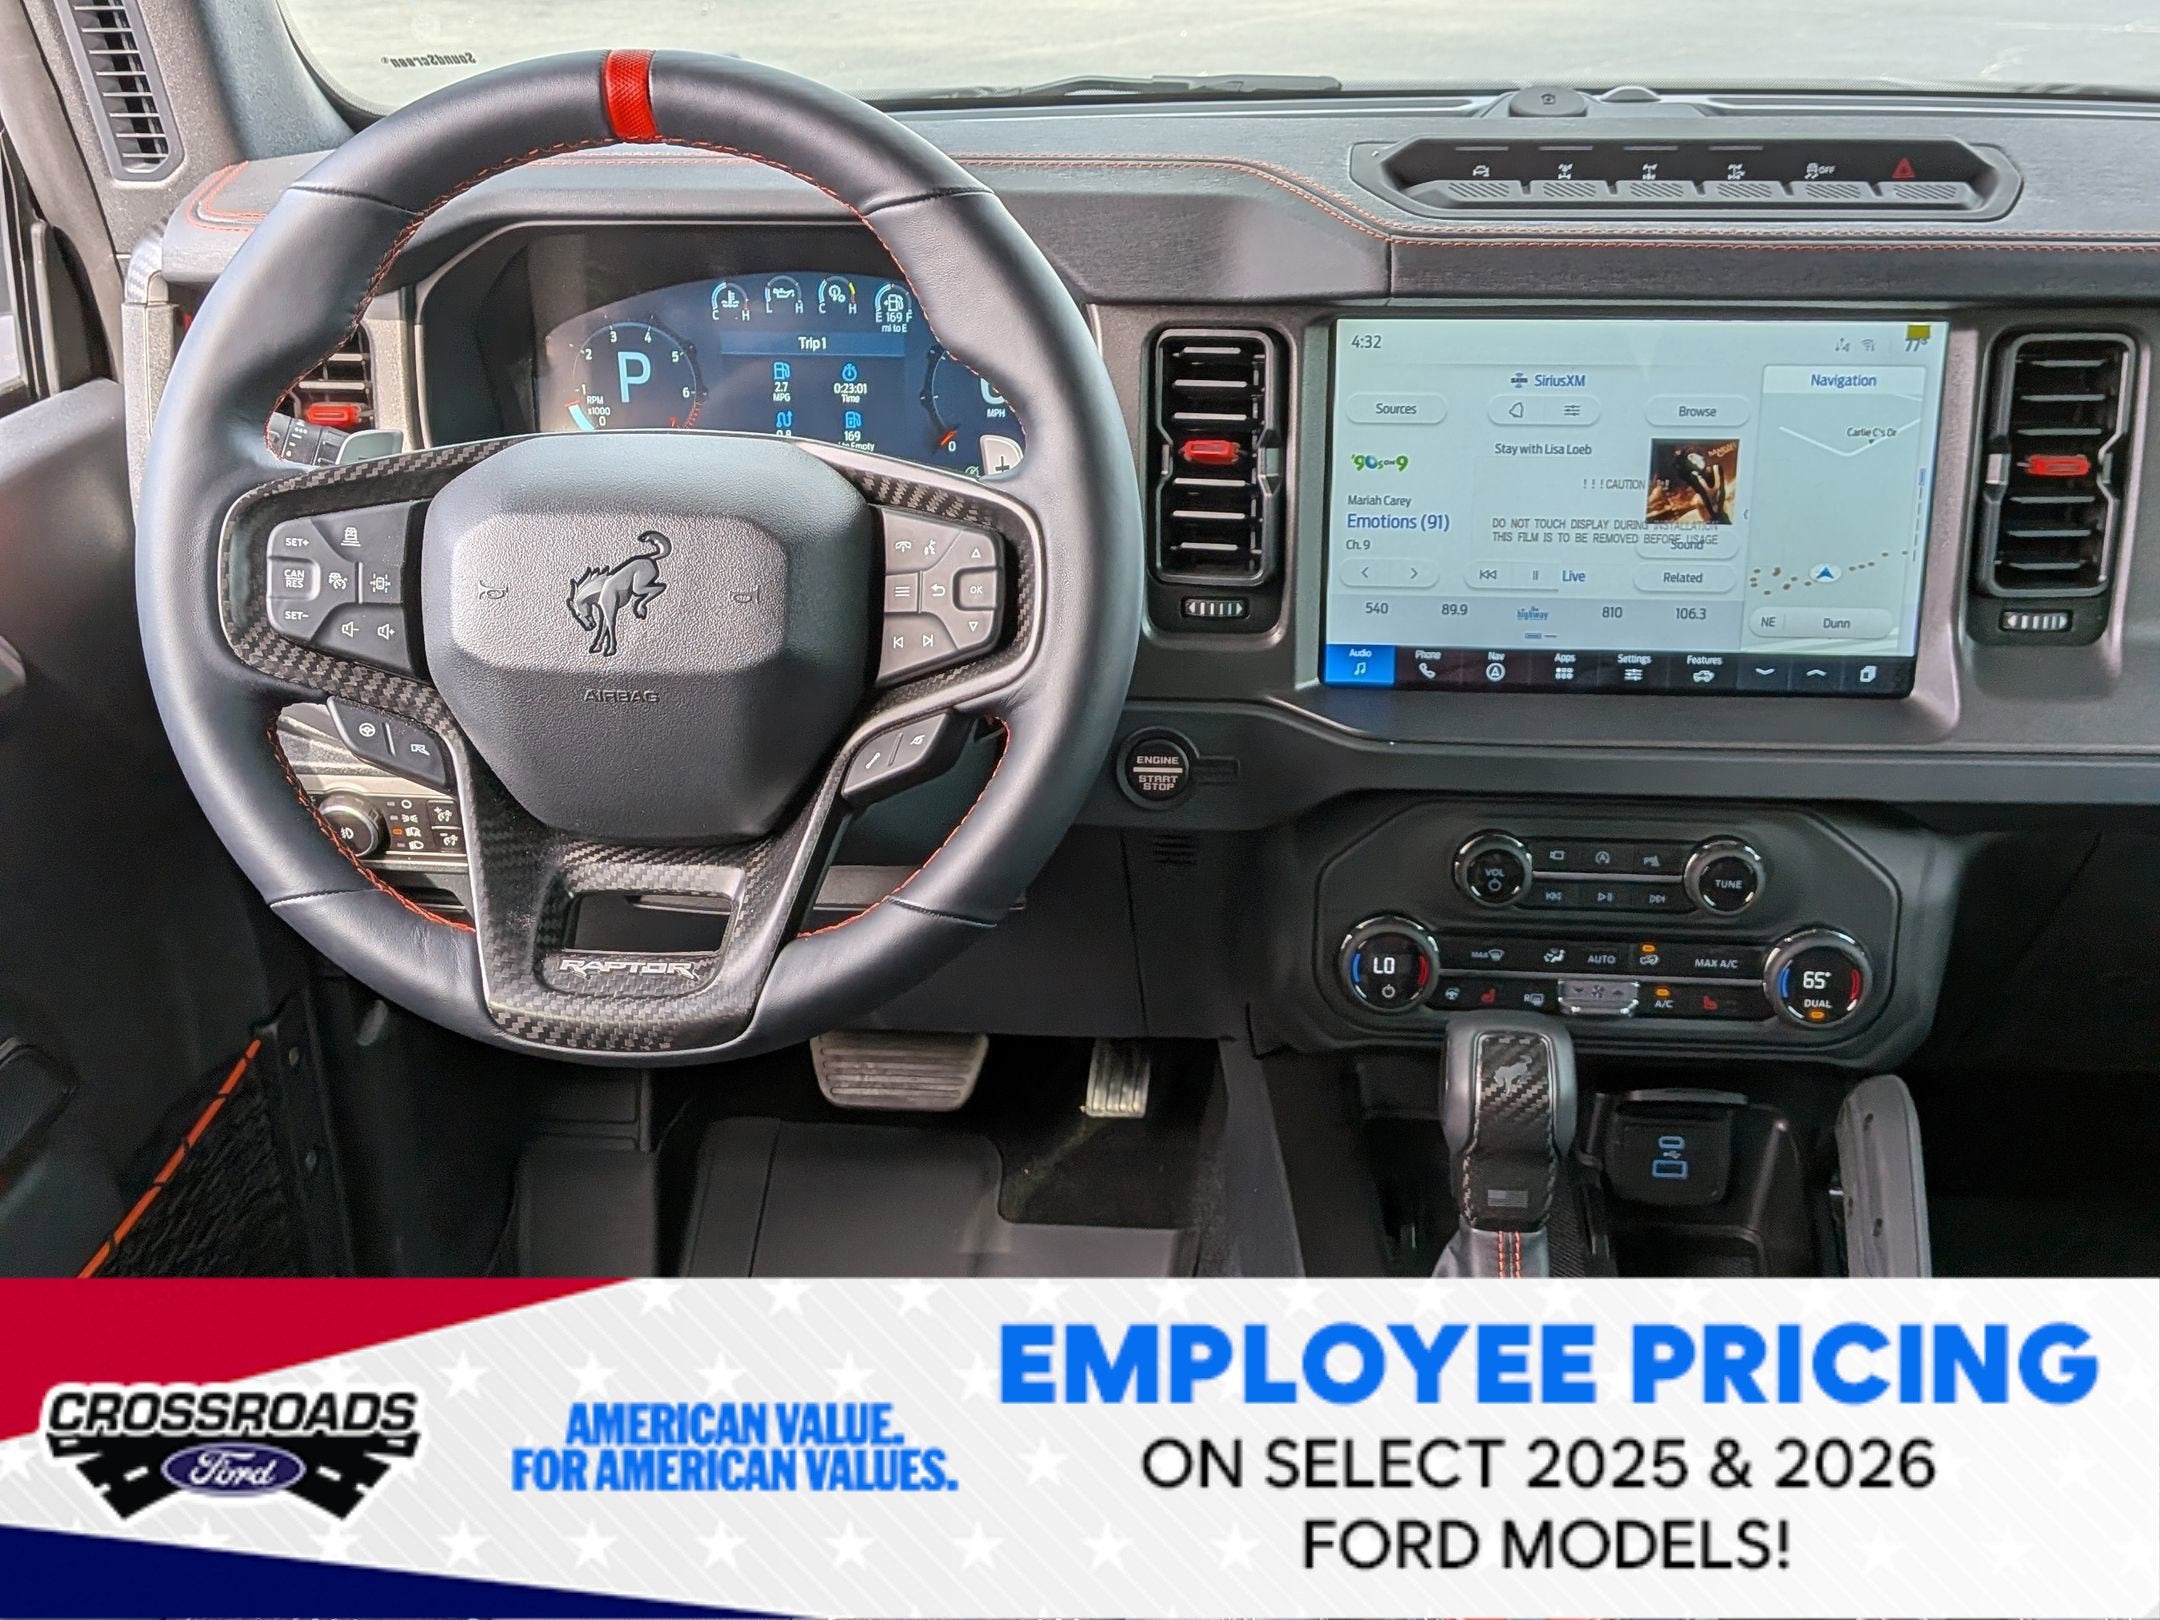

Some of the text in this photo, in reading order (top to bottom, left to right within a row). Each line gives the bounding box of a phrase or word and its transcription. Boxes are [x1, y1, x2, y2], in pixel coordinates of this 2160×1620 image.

[610, 334, 618, 343] 3
[644, 334, 652, 344] 4
[798, 337, 819, 352] Trip
[1351, 334, 1382, 350] 4:32
[585, 349, 593, 361] 2
[671, 350, 680, 363] 5
[617, 351, 651, 403] P
[1534, 374, 1586, 388] SiriusXM
[1811, 373, 1877, 389] Navigation
[681, 386, 690, 399] 6
[774, 381, 789, 393] 2.7
[833, 382, 868, 395] 0:23:01
[586, 395, 604, 405] RPM
[772, 392, 791, 403] MPG
[841, 393, 861, 404] Time
[986, 408, 1006, 419] MPH
[1376, 402, 1417, 416] Sources
[1678, 405, 1717, 418] Browse
[598, 415, 607, 427] 0
[844, 430, 861, 442] 169
[948, 441, 957, 453] 0
[1495, 443, 1592, 456] Stay with Lisa Loeb
[1605, 479, 1646, 489] CAUTION
[1347, 495, 1412, 508] Mariah Carey
[1347, 513, 1450, 532] Emotions (91)
[1492, 518, 1506, 529] DO
[1511, 518, 1530, 529] NOT
[1535, 518, 1566, 530] TOUCH
[1571, 518, 1609, 530] DISPLAY
[1614, 519, 1649, 531] DURING
[1493, 532, 1719, 545] THIS FILM IS TO BE REMOVED BEFORE USAGE
[1671, 539, 1704, 550] Sound
[1346, 540, 1371, 550] Ch. 9
[284, 569, 305, 578] CAN
[1562, 569, 1586, 583] Live
[1663, 571, 1703, 584] Related
[285, 579, 304, 589] RES
[969, 585, 983, 595] OK
[1365, 602, 1389, 615] 540
[1441, 603, 1468, 616] 89.9
[1602, 606, 1623, 618] 810
[1676, 607, 1706, 621] 106.3
[1761, 617, 1776, 628] NE
[1823, 617, 1851, 630] Dunn
[1349, 648, 1372, 658] Audio
[1415, 650, 1442, 660] Phone
[1488, 651, 1505, 661] Nav
[1554, 653, 1576, 664] Apps
[1617, 654, 1651, 666] Settings
[1687, 655, 1722, 666] Features
[584, 689, 660, 703] AIRBAG
[1136, 756, 1179, 765] ENGINE
[1138, 775, 1178, 783] START
[1142, 783, 1175, 791] STOP
[1485, 868, 1505, 878] VOL
[1715, 879, 1742, 889] TUNE
[1587, 955, 1616, 965] AUTO
[1694, 959, 1739, 969] MAX A/C
[559, 959, 699, 981] RAPTOR
[1803, 971, 1832, 990] 65°
[1655, 999, 1673, 1009] A/C
[1804, 999, 1832, 1009] DUAL
